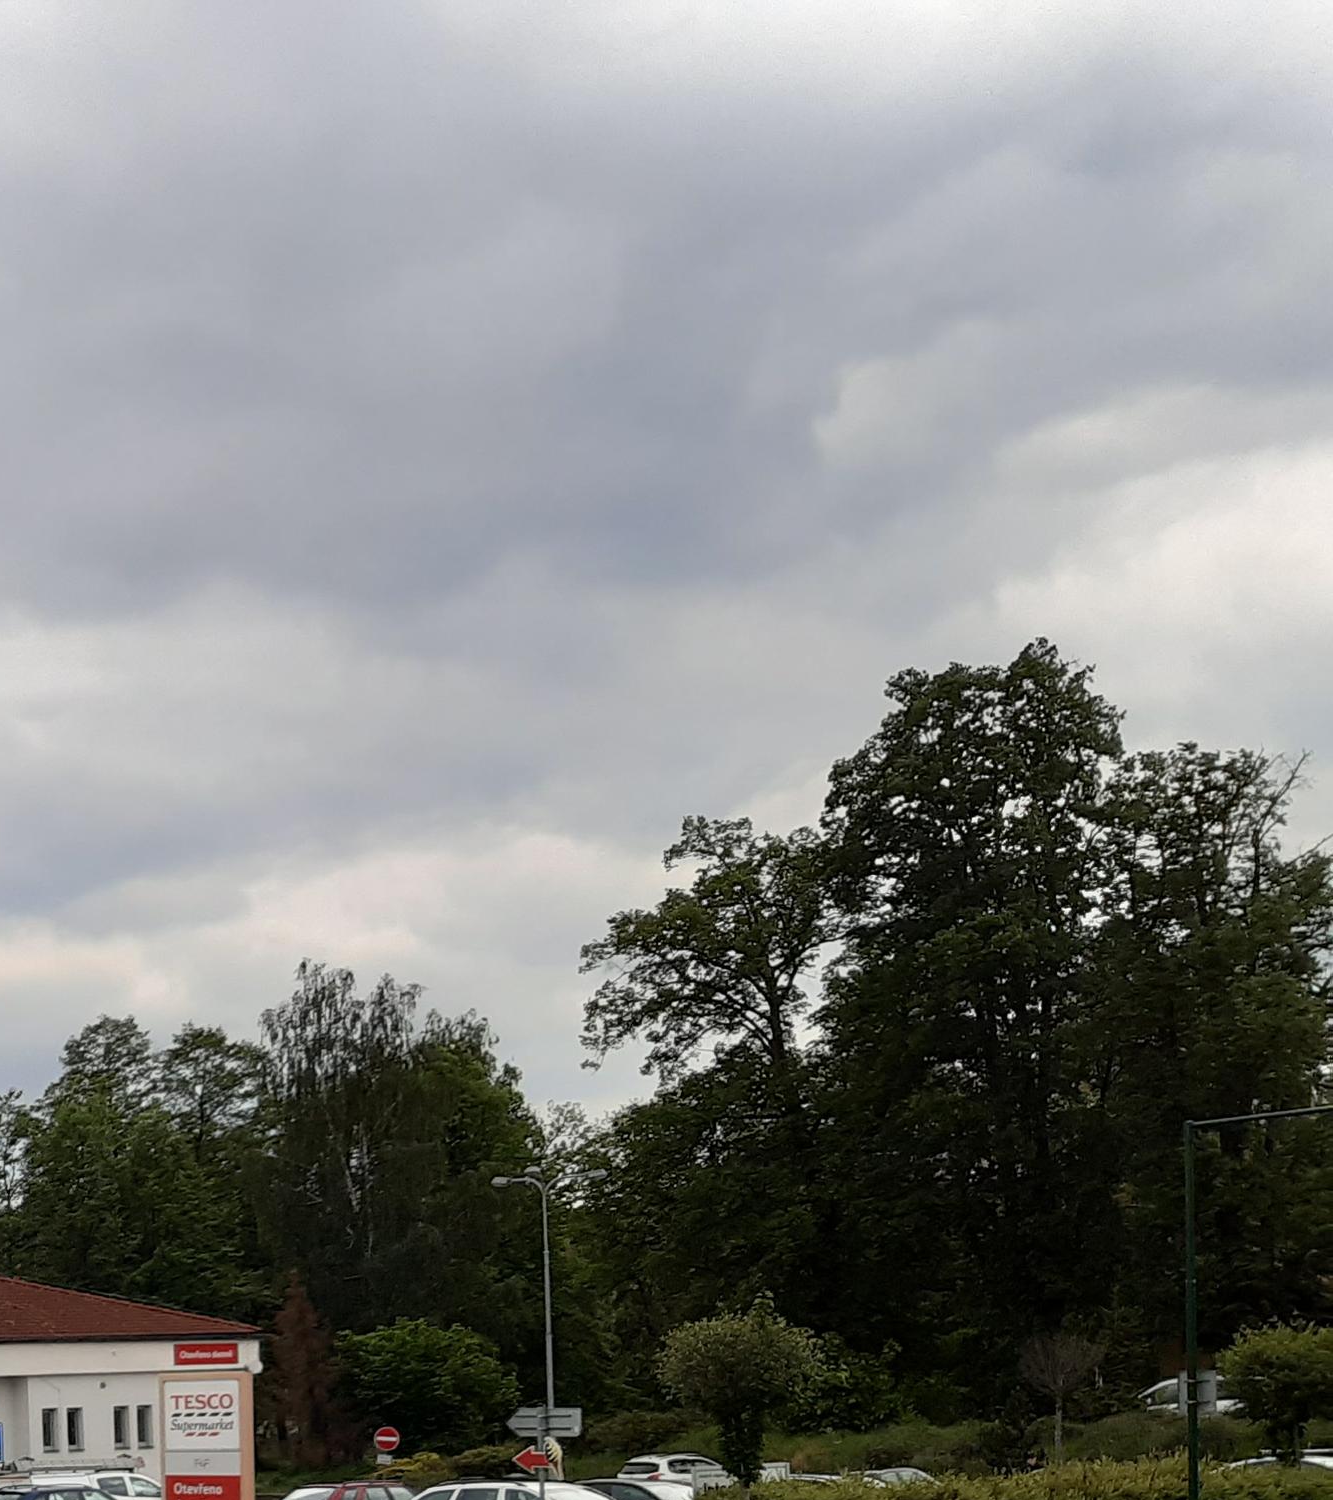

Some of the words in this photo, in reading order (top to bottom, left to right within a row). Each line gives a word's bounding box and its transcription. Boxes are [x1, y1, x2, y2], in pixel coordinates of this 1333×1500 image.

[170, 1394, 234, 1410] TESCO
[170, 1419, 234, 1433] Supermarket
[174, 1483, 223, 1495] Otevřeno
